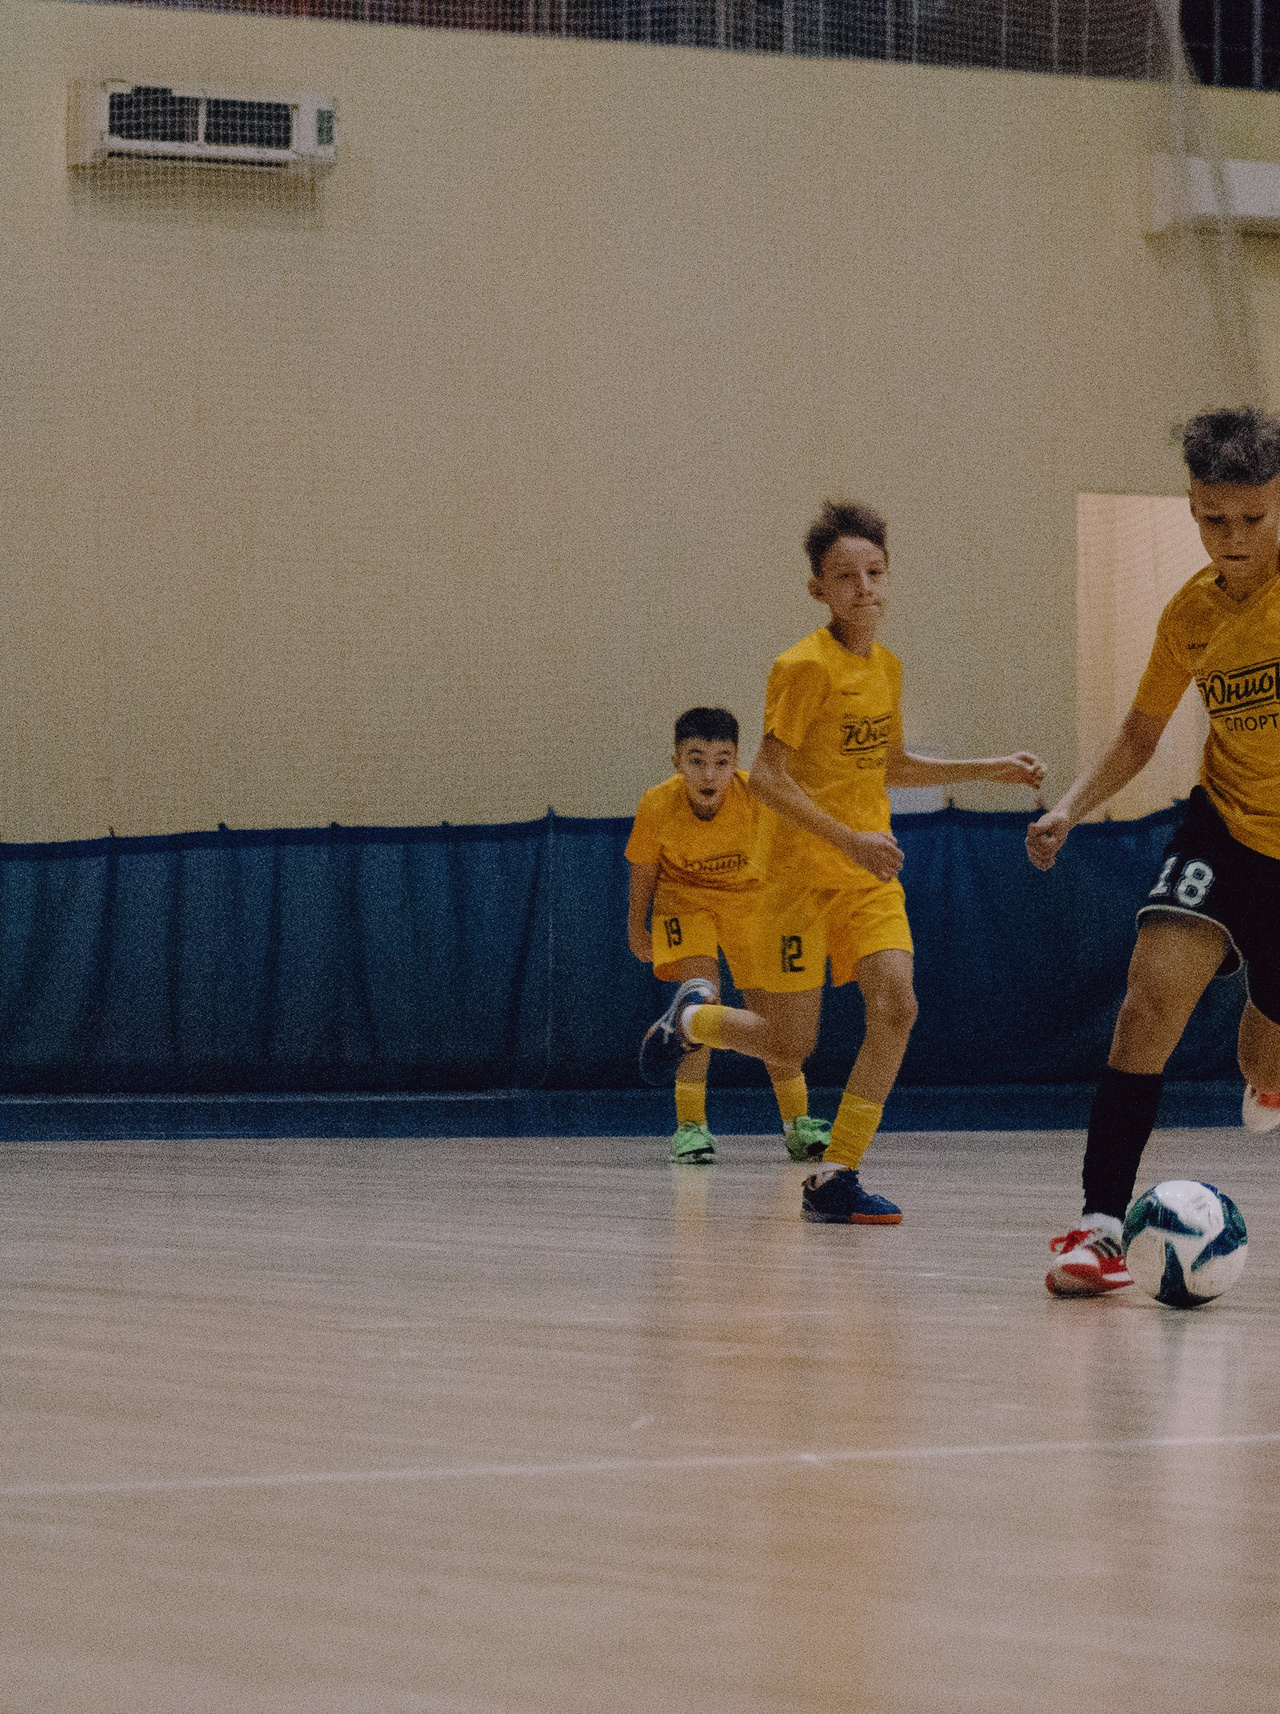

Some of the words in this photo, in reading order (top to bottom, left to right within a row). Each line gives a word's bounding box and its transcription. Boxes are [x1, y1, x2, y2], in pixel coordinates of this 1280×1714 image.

[1224, 713, 1280, 732] СПОРТ
[1149, 853, 1215, 908] 18
[664, 917, 683, 949] 19
[780, 935, 806, 974] 12
